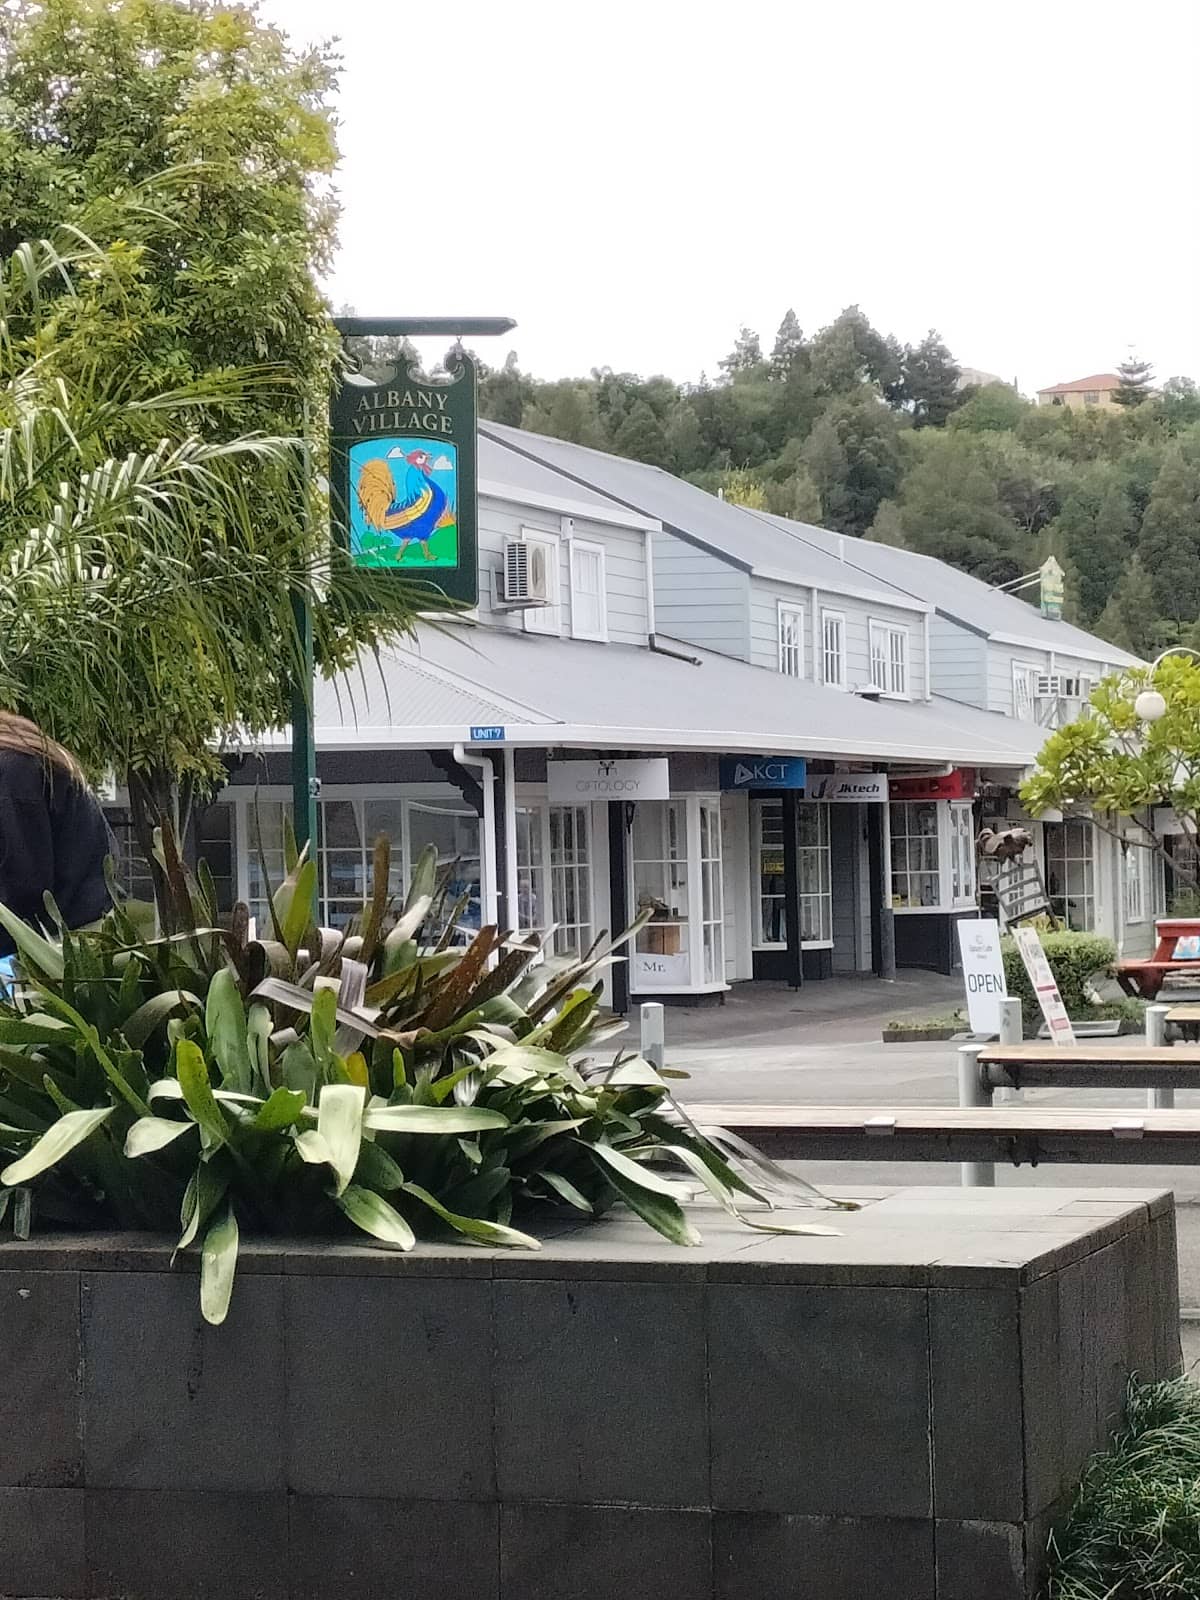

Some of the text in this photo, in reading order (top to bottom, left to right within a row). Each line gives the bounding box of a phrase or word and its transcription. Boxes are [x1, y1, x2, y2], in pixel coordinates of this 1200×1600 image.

[356, 390, 448, 412] ALBANY
[352, 413, 453, 435] VILLAGE
[473, 728, 493, 739] UNIT
[754, 764, 789, 780] KCT
[575, 780, 641, 793] GIFTOLOGY
[643, 961, 666, 973] Mr.
[968, 973, 1003, 993] OPEN
